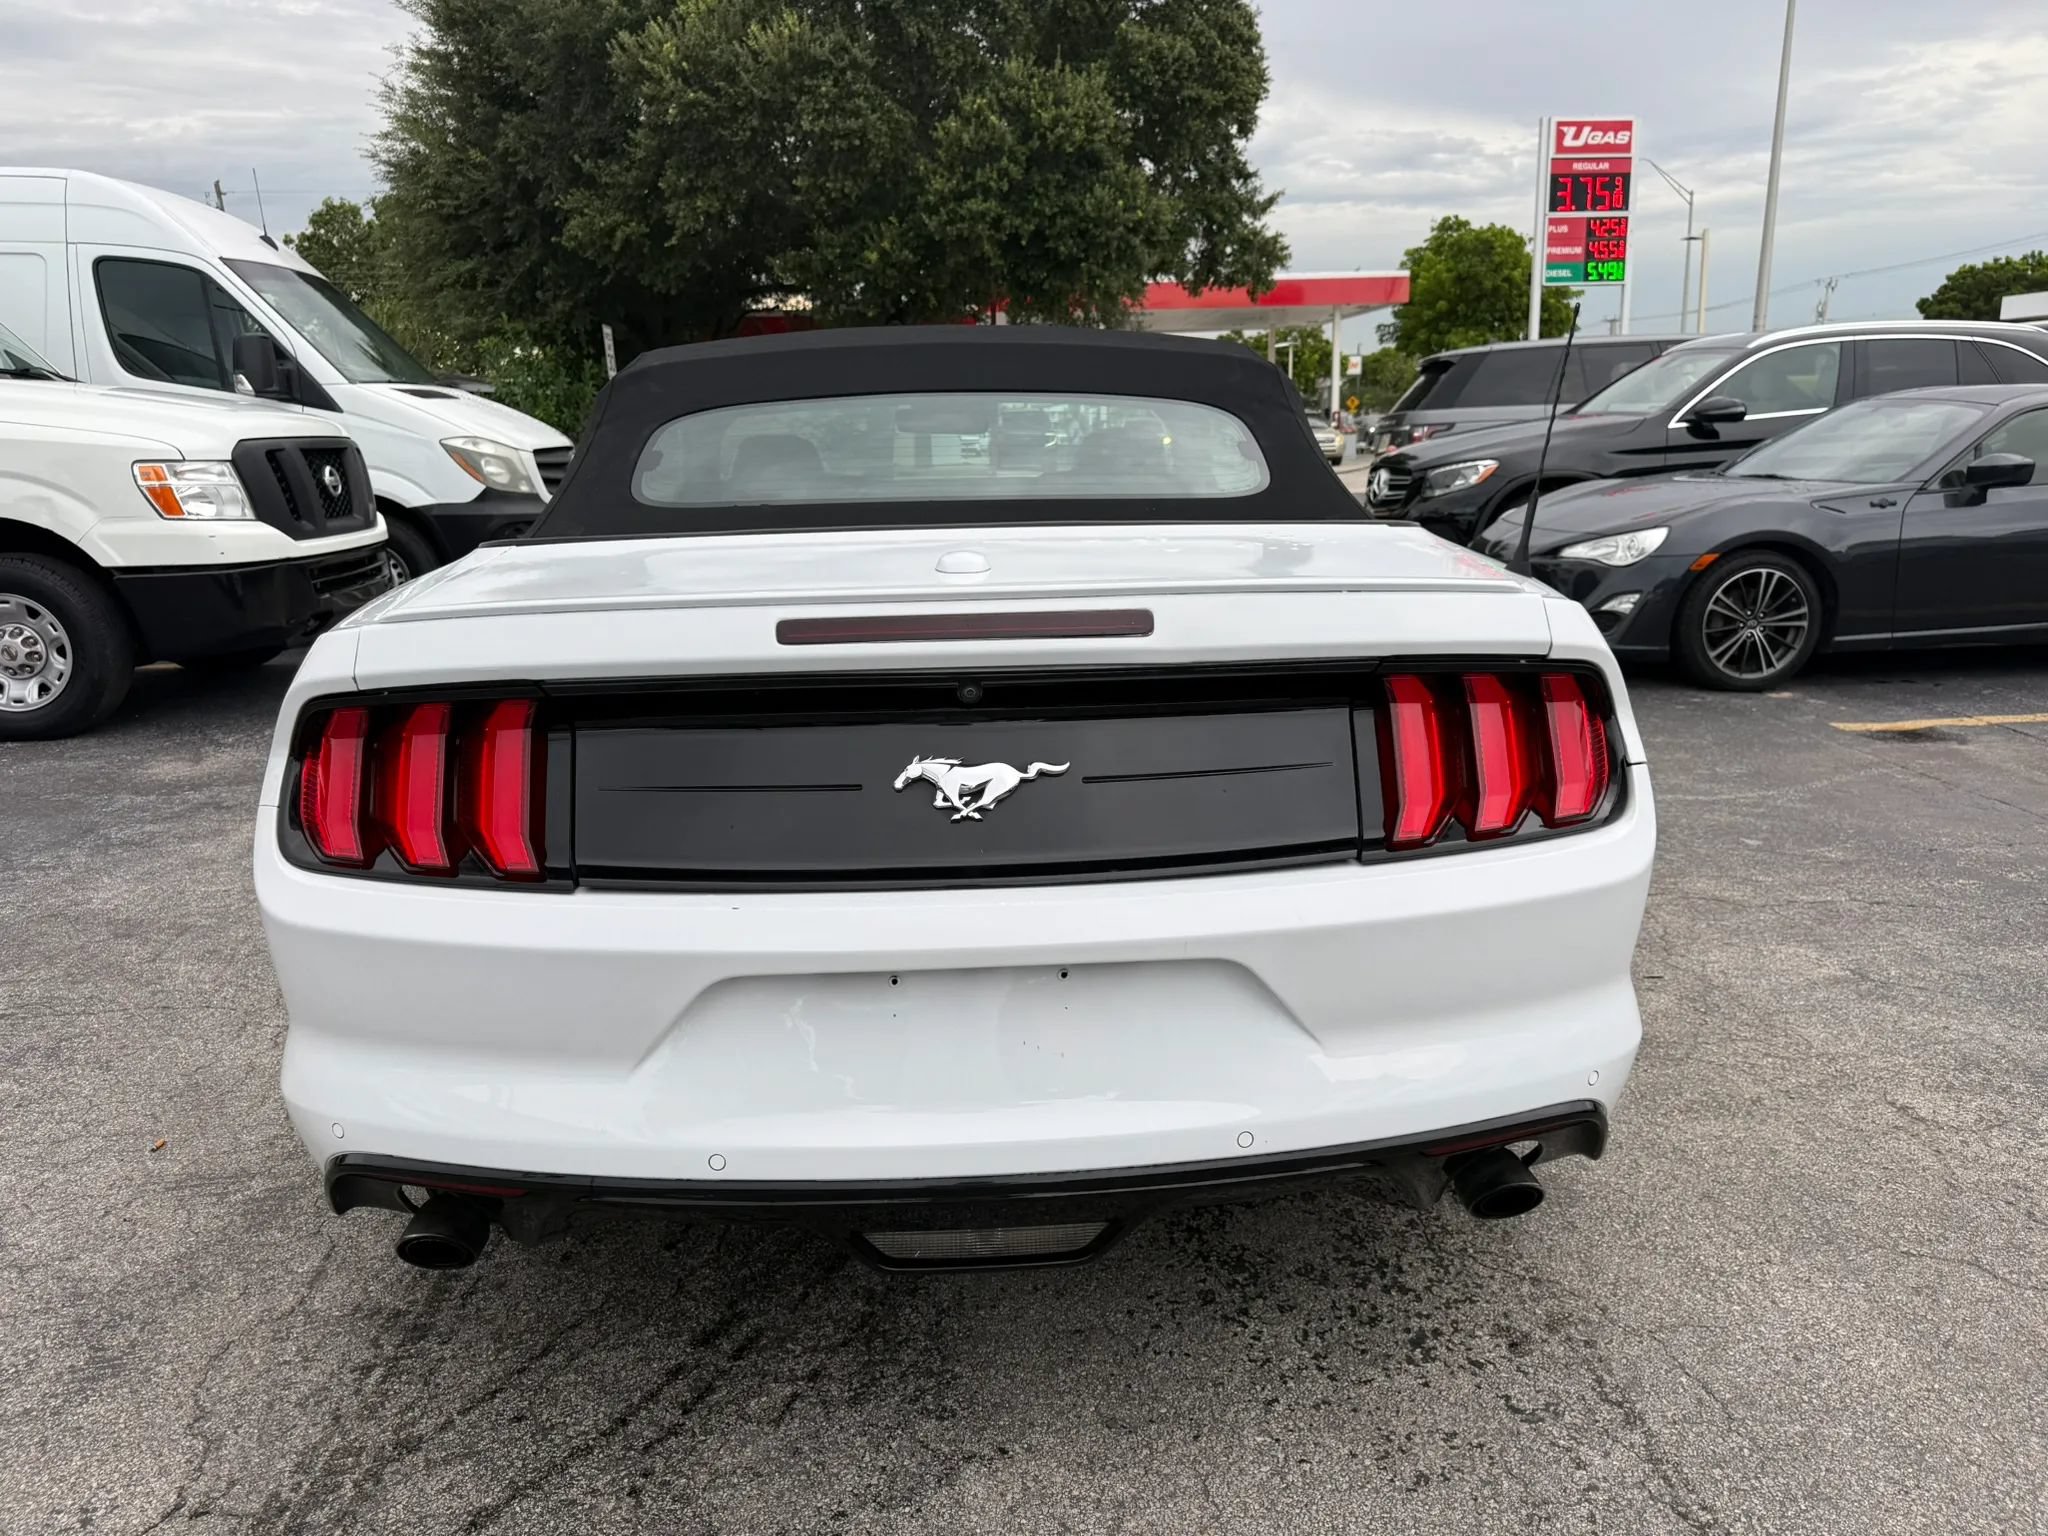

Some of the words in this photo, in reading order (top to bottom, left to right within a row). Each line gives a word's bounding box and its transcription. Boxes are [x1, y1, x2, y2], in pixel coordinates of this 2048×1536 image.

[1559, 126, 1631, 147] UGAS
[1572, 162, 1610, 171] REGULAR
[1548, 224, 1569, 234] PLUS
[1546, 245, 1583, 256] PREMIUM
[1545, 268, 1573, 278] DIESEL
